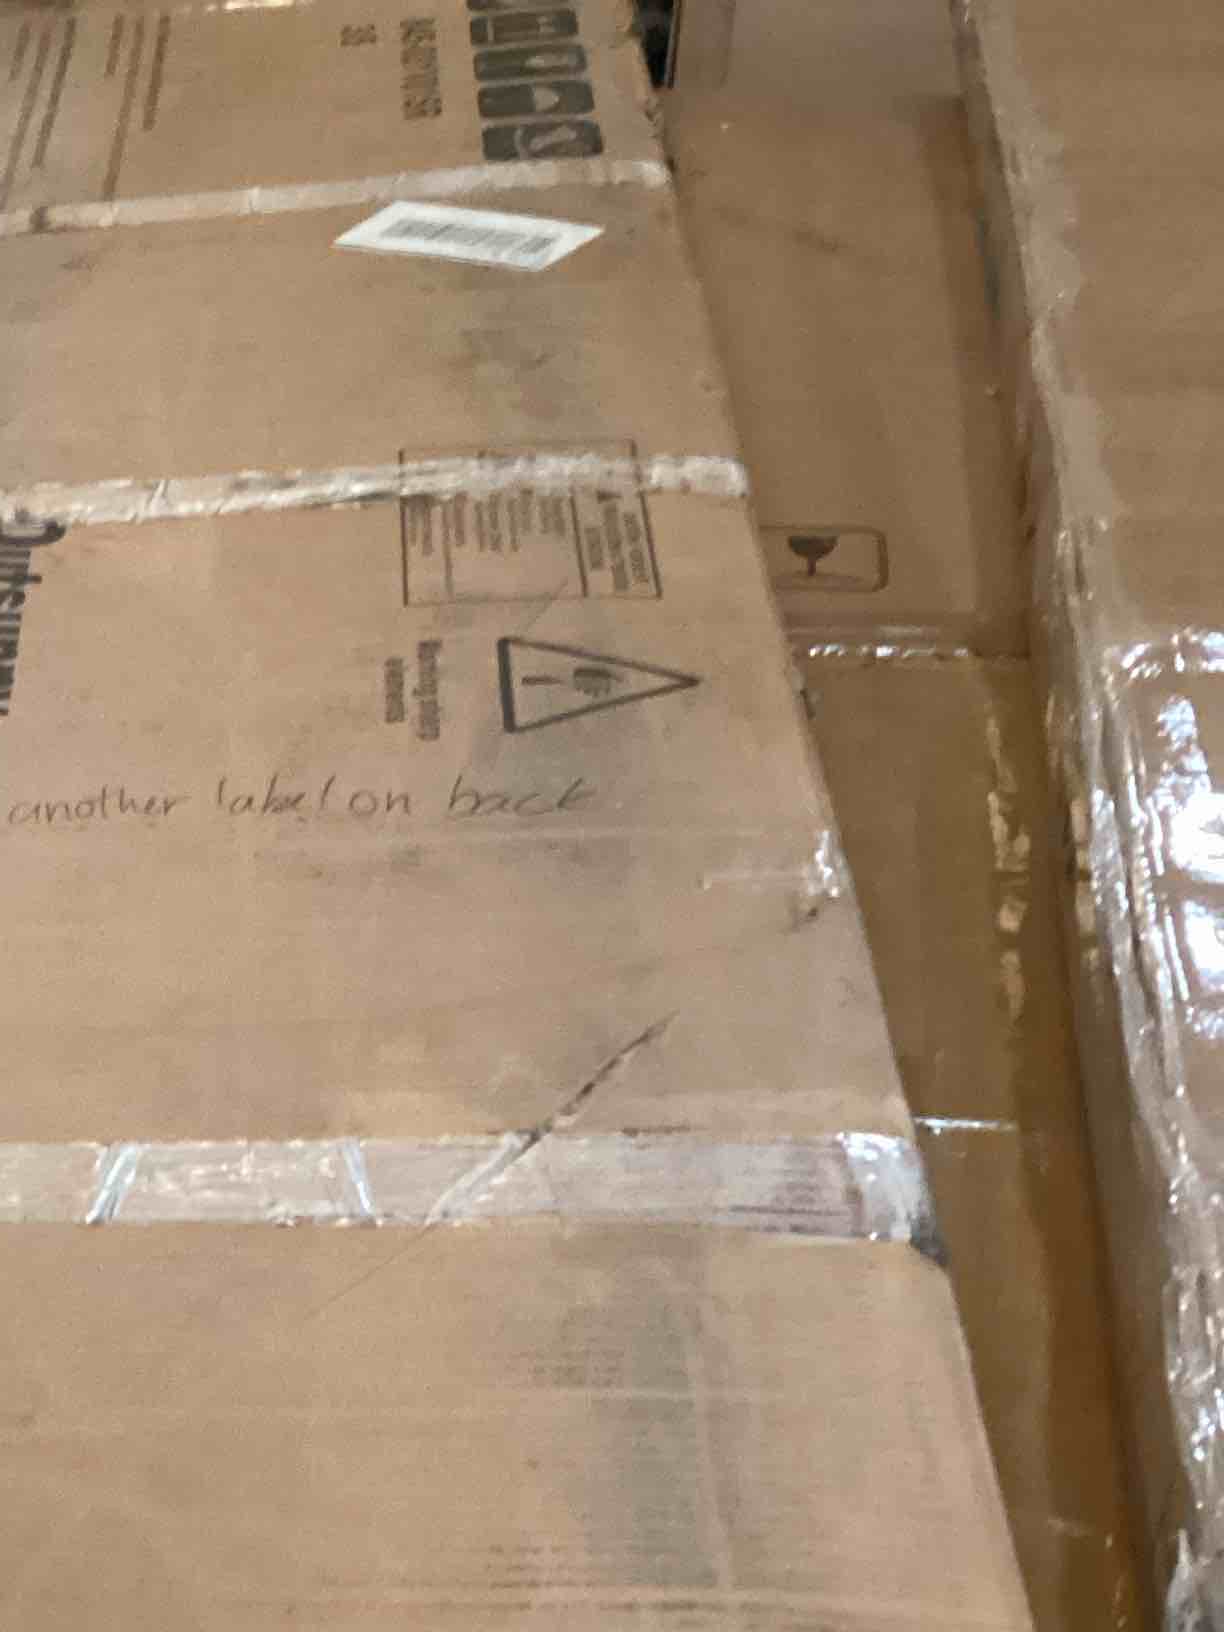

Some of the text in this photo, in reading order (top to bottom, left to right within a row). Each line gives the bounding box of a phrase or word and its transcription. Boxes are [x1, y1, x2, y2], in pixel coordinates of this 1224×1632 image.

[7, 785, 192, 825] another
[347, 788, 413, 818] on
[446, 774, 599, 822] back
